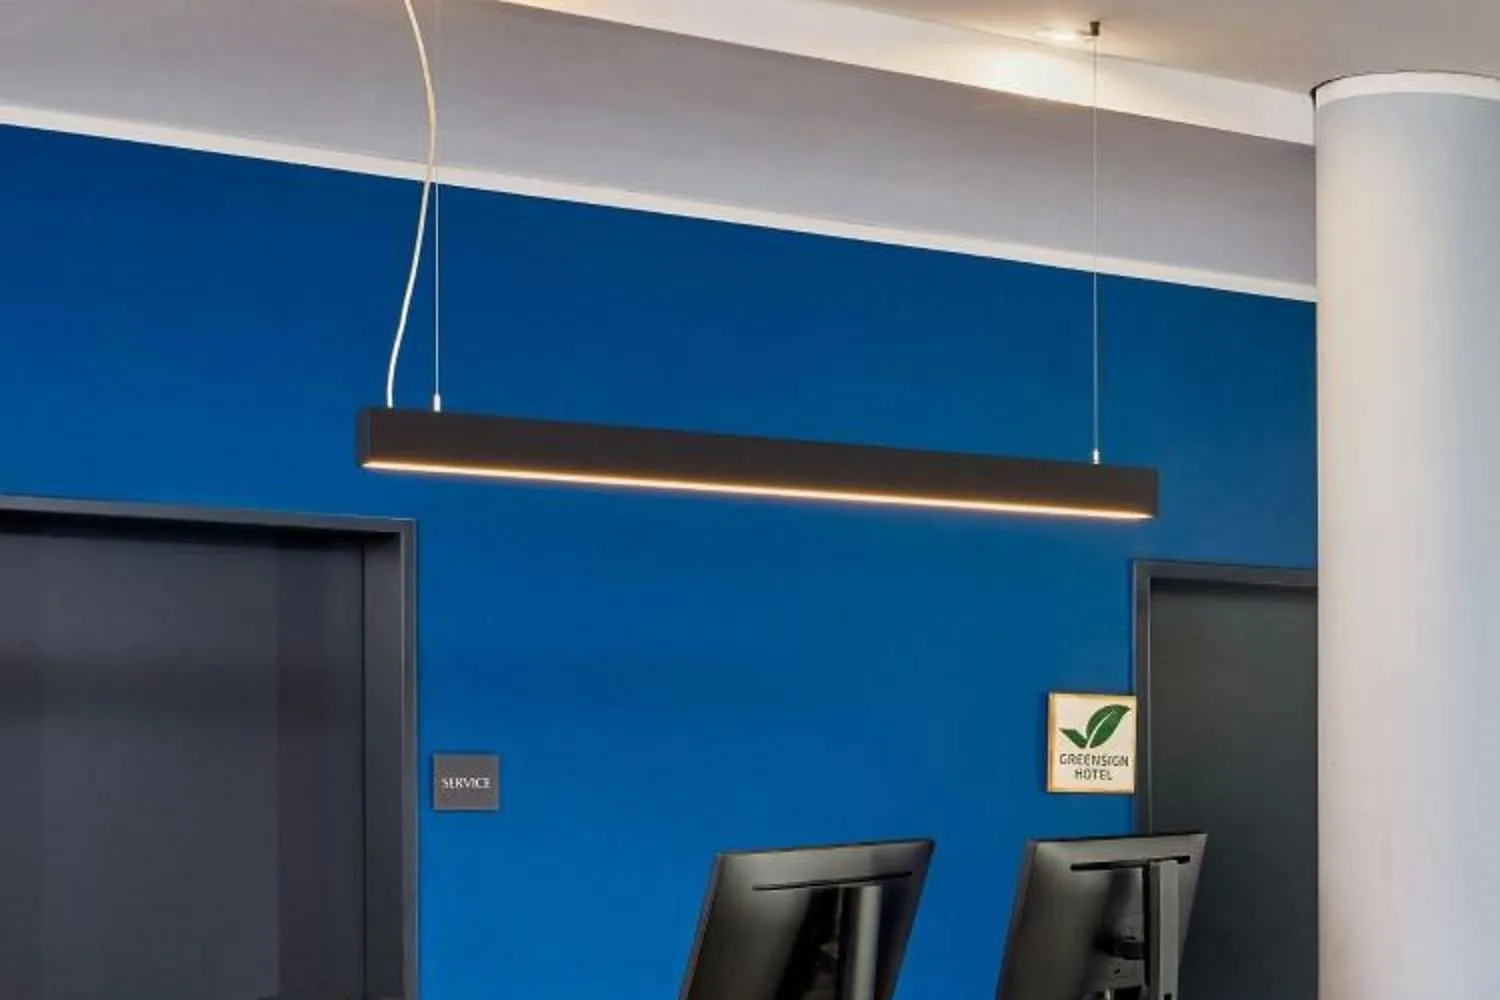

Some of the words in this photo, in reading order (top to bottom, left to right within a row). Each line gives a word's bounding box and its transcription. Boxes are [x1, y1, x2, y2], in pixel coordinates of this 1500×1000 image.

[1059, 753, 1129, 767] GREENSIGN
[1075, 768, 1113, 781] HOTEL
[441, 776, 490, 789] SERVICE
